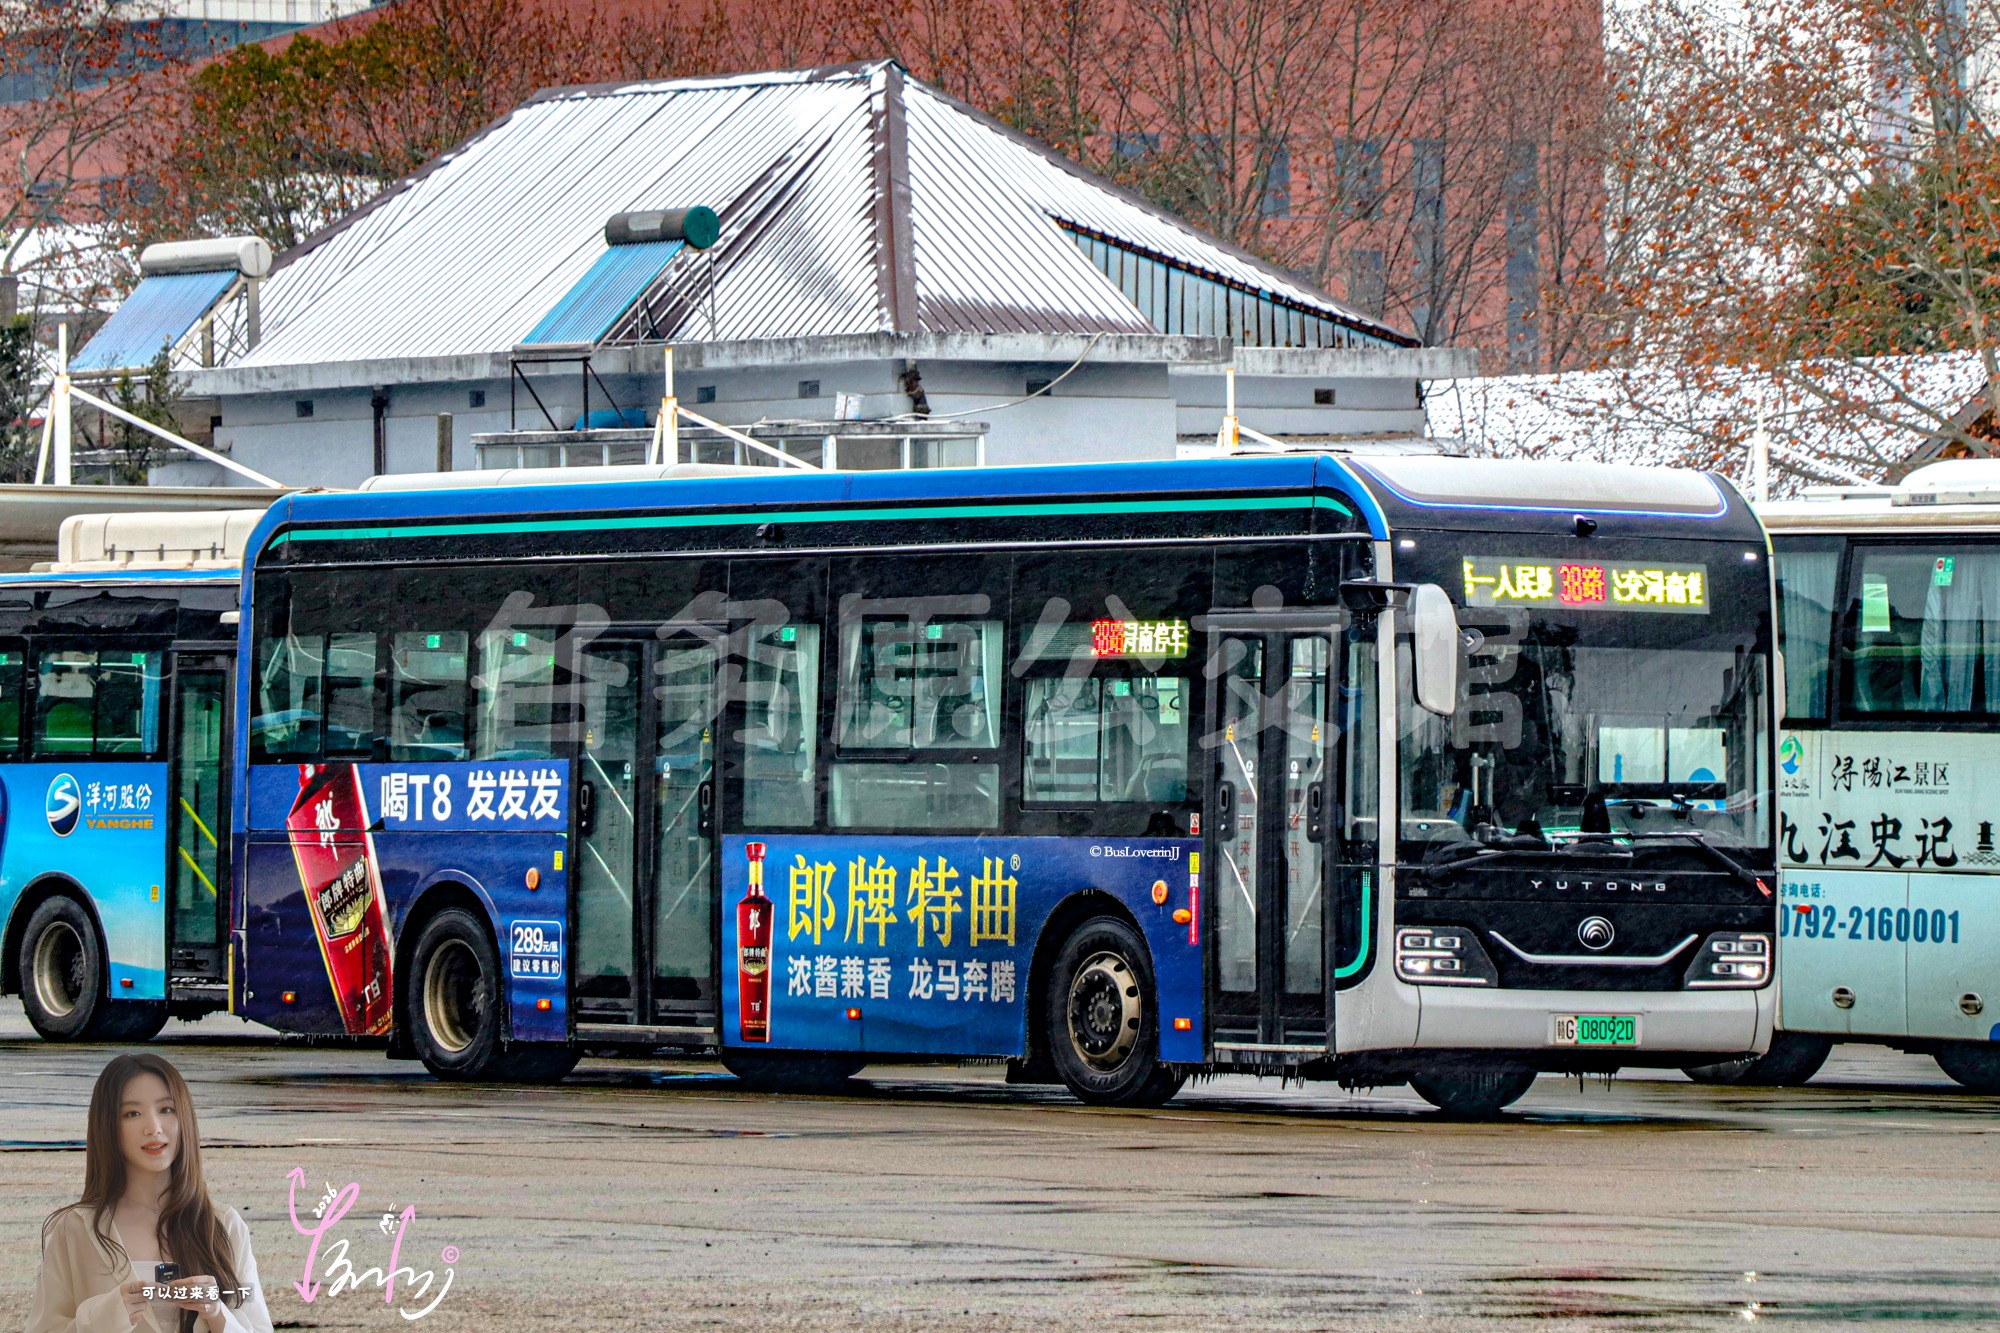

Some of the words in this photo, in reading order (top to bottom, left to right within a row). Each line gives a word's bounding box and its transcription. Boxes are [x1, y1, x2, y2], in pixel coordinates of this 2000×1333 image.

[86, 781, 153, 815] 洋河股份
[381, 772, 452, 822] 喝T8
[466, 769, 562, 821] 发发发
[86, 819, 154, 830] YANGHE
[1531, 879, 1666, 892] YUTONG
[1780, 904, 1960, 944] 0792-2160001
[787, 955, 892, 1000] 浓酱兼香
[908, 956, 1017, 1003] 龙马奔腾
